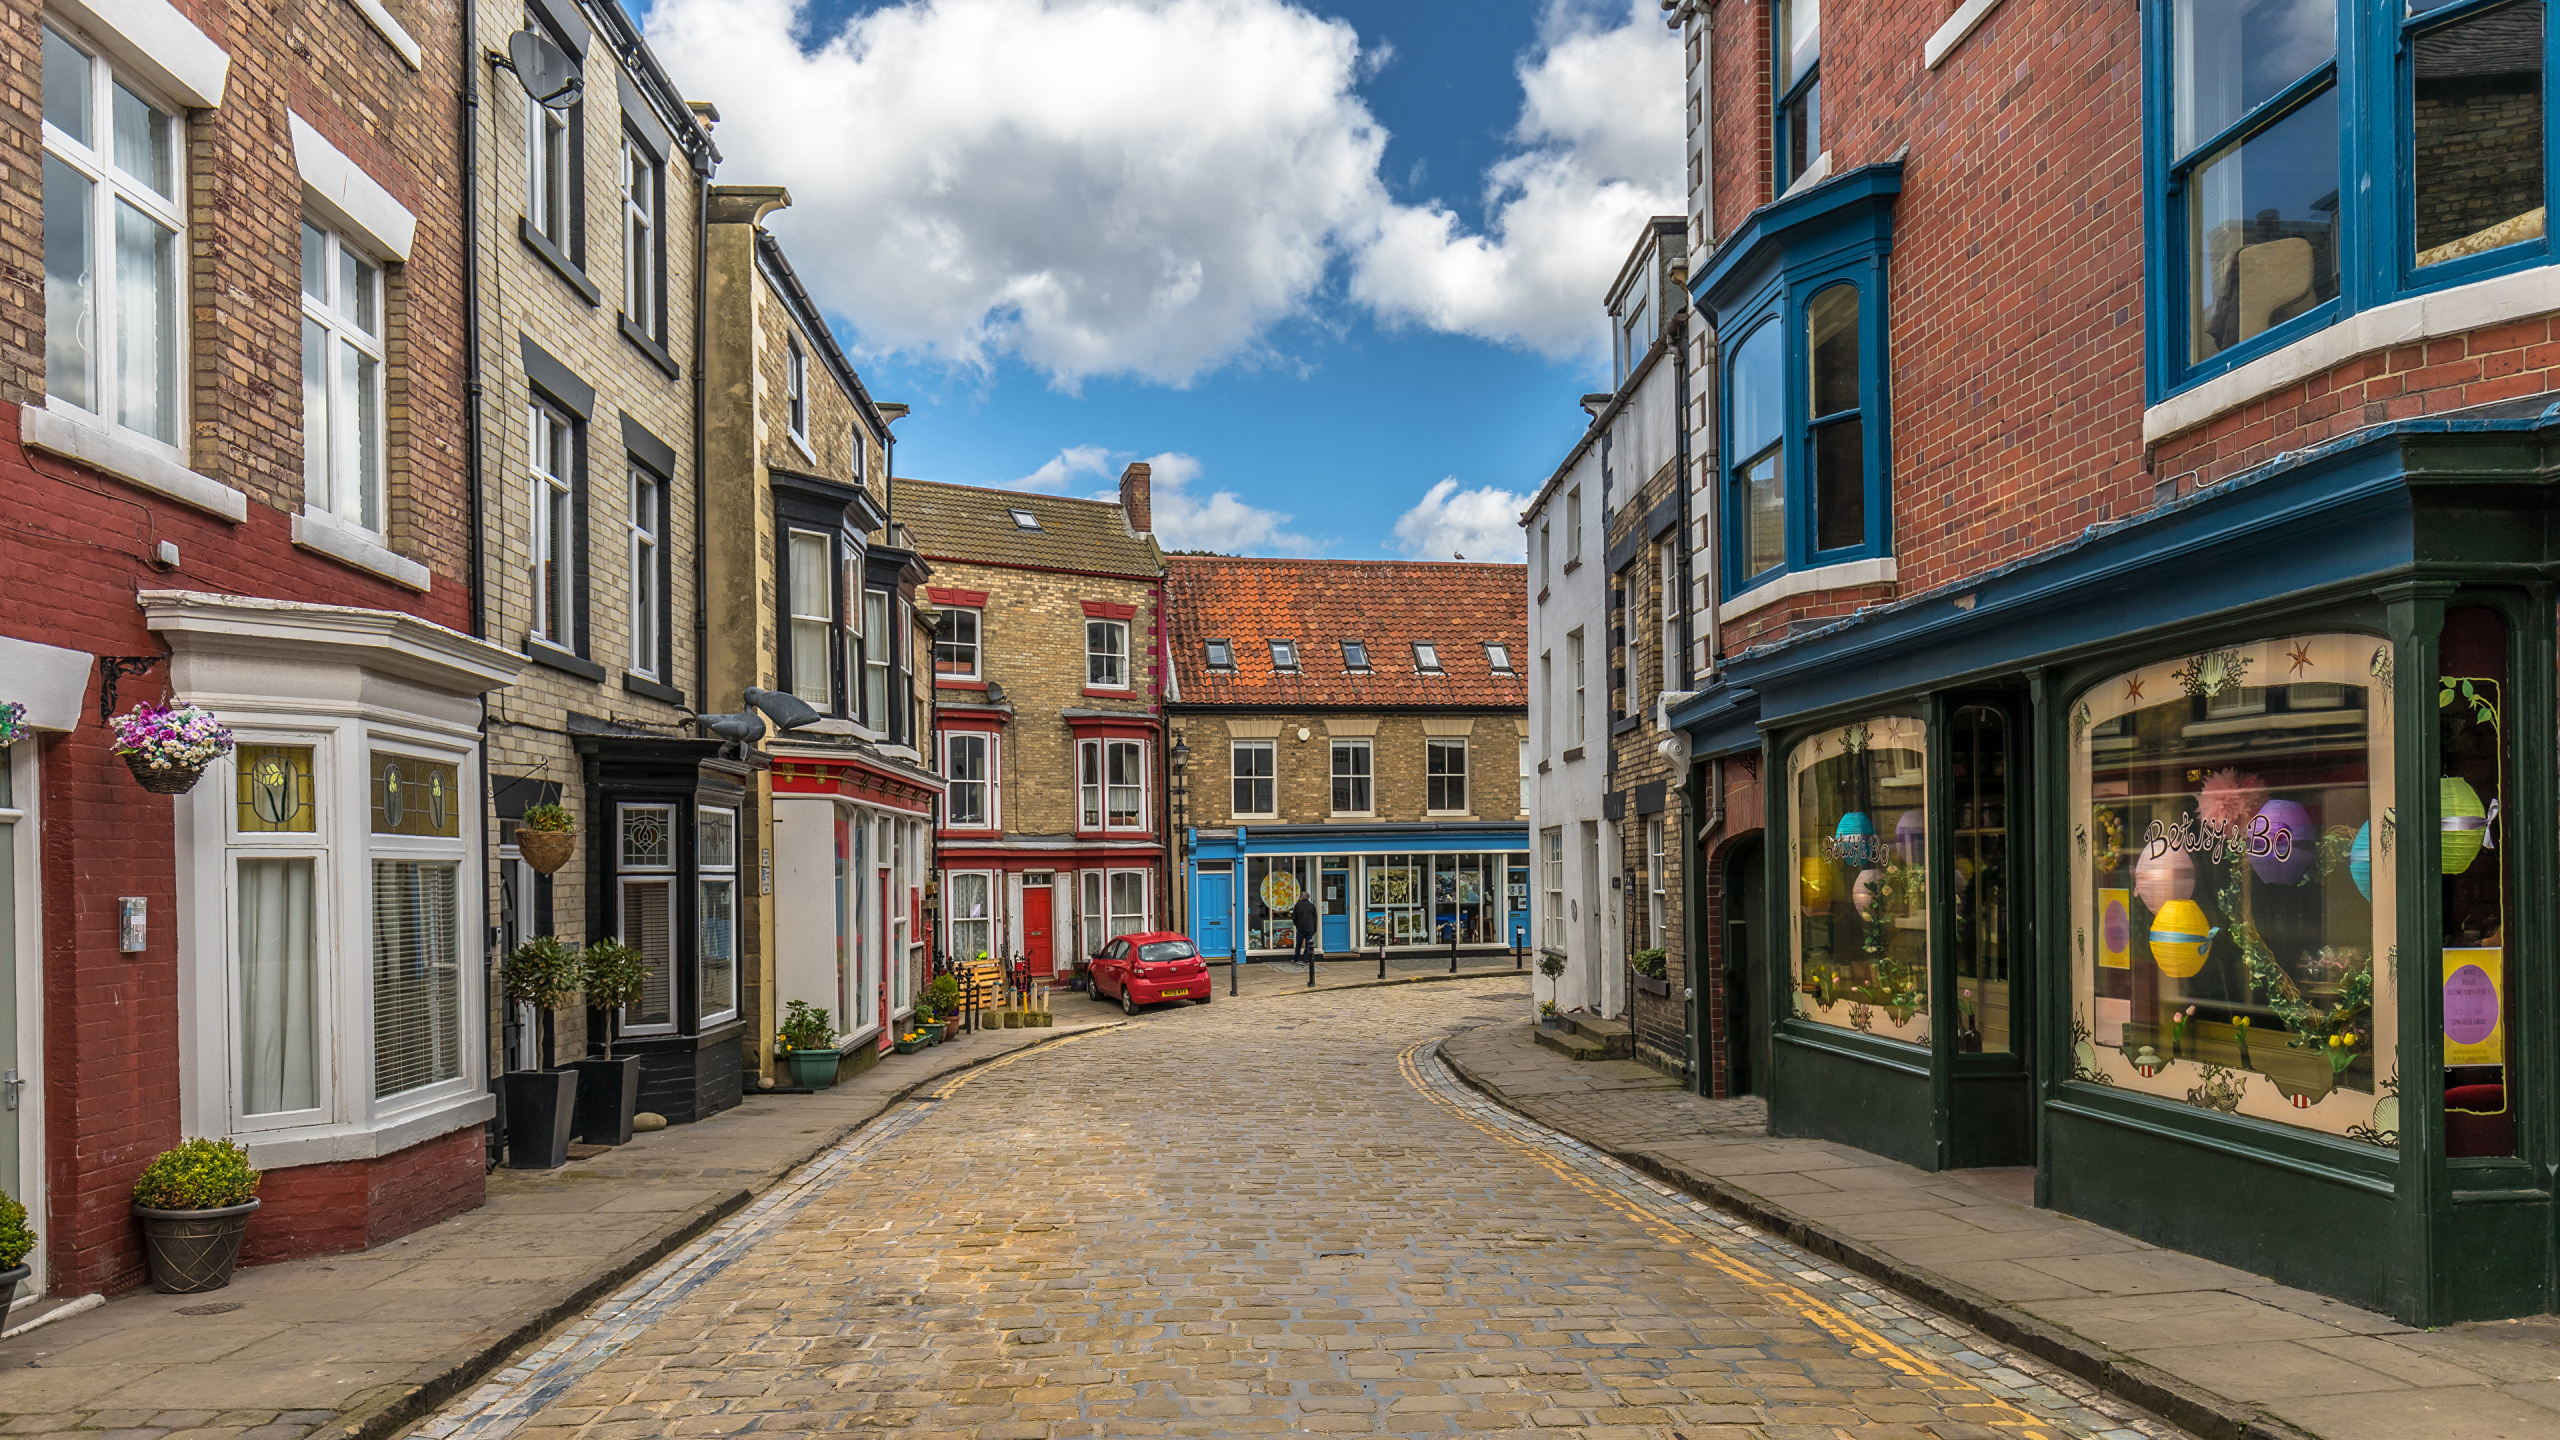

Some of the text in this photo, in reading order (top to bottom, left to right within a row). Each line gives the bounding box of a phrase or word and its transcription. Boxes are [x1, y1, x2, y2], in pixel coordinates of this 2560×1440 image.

[1822, 832, 1860, 867] Betsy
[1868, 834, 1890, 866] Bo
[2144, 811, 2292, 865] Betsy & Bo
